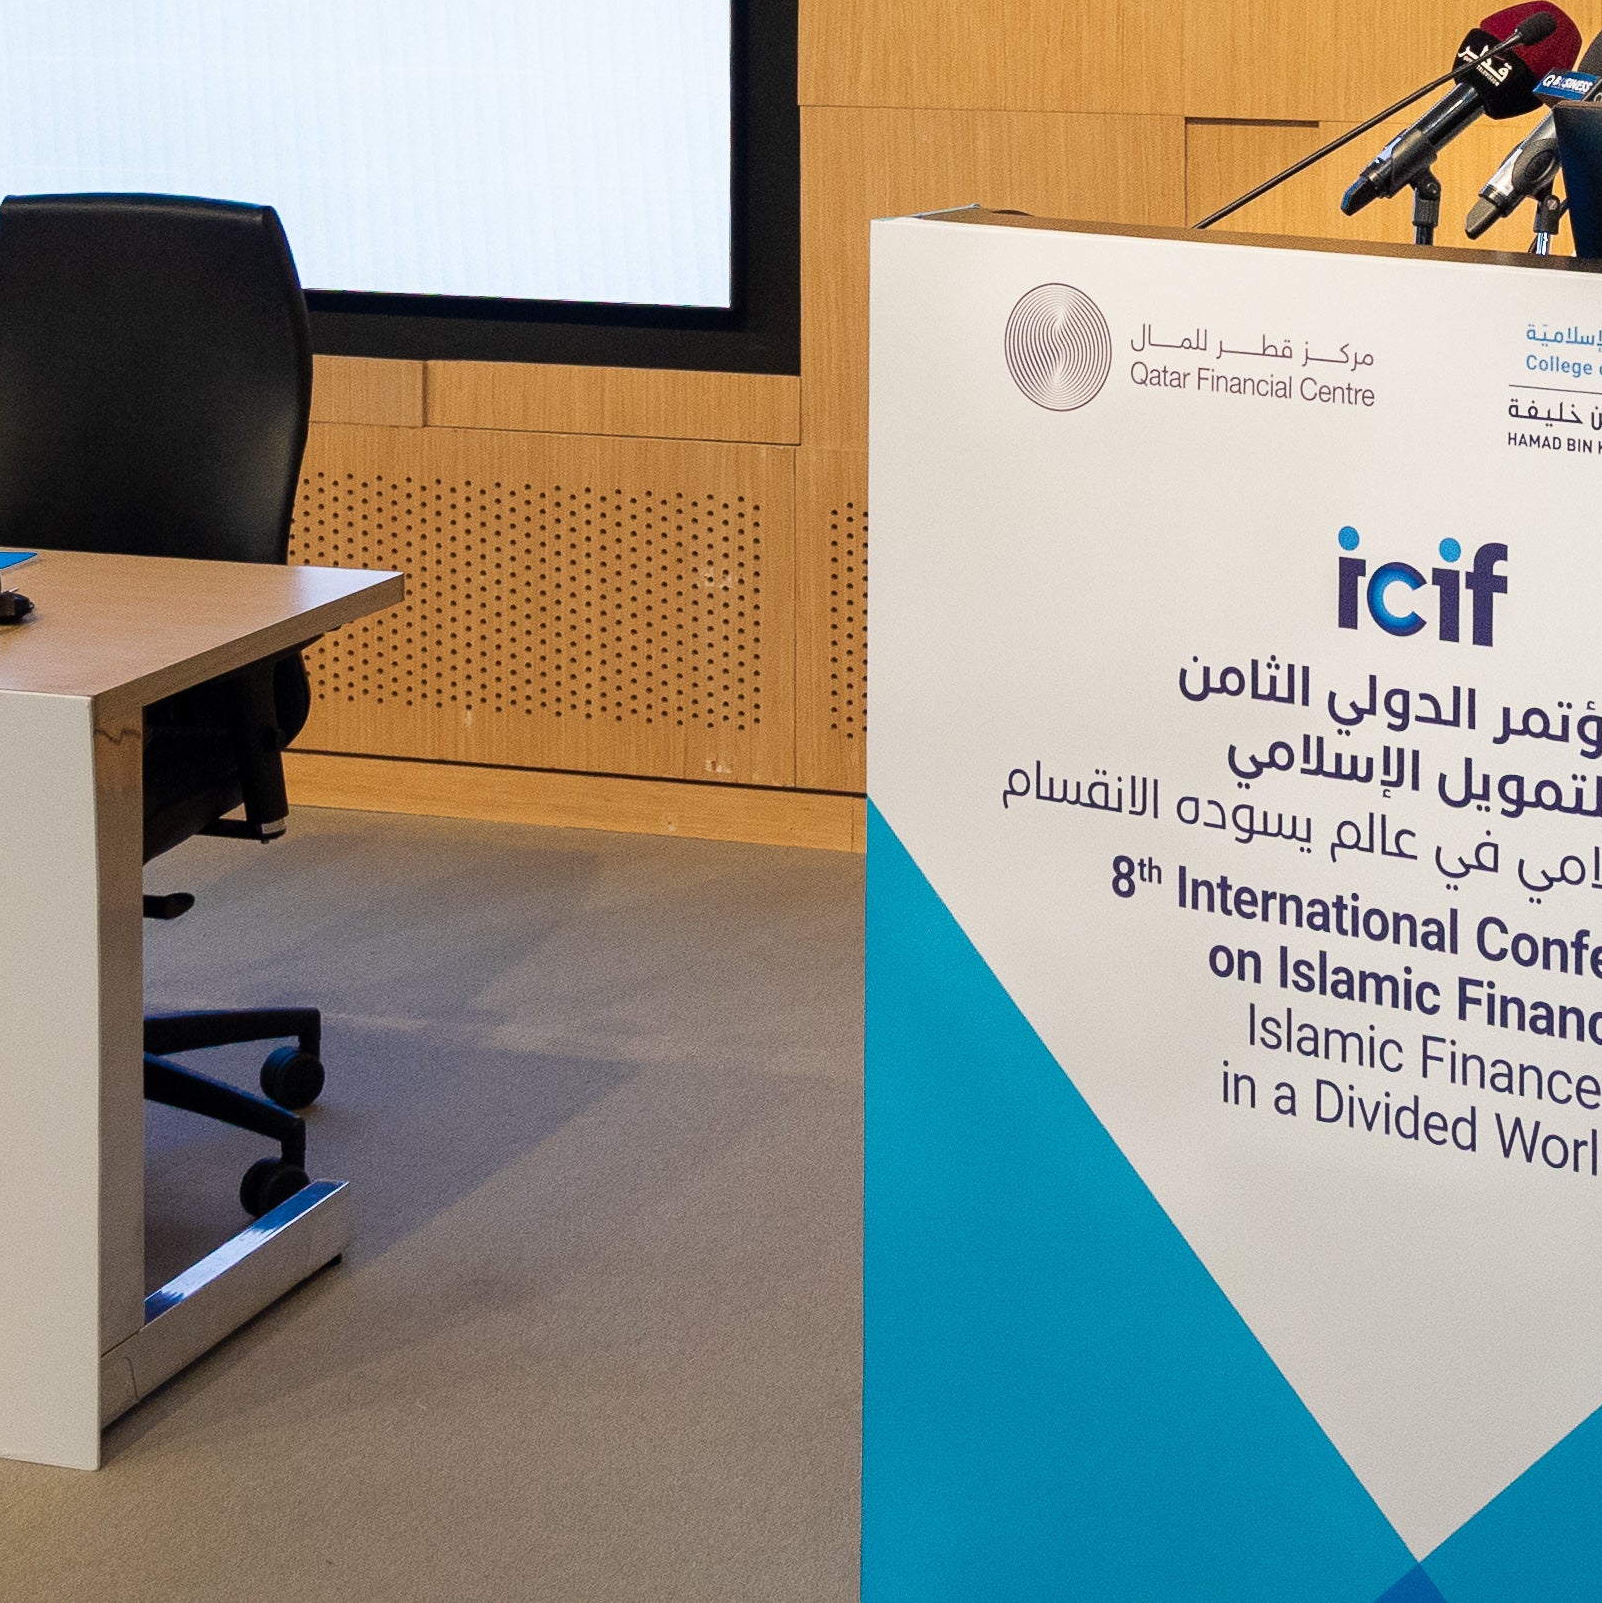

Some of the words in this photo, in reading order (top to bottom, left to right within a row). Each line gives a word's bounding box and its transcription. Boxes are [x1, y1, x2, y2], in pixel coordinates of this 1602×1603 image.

[1131, 324, 1207, 351] للمال
[1216, 334, 1292, 359] قطر
[1302, 344, 1373, 371] مركز
[1527, 355, 1592, 378] College
[1131, 362, 1190, 388] Qatar
[1198, 368, 1292, 398] Financial
[1300, 377, 1374, 406] Centre
[1508, 399, 1583, 427] خليفة
[1508, 432, 1561, 450] HAMAD
[1567, 438, 1592, 453] BIN
[1338, 526, 1508, 647] icif
[1179, 655, 1309, 707] الثامن
[1328, 675, 1475, 736] الدولي
[1003, 760, 1158, 819] الانقسام
[1228, 729, 1419, 798] الإسلامي
[1177, 782, 1311, 853] يسوده
[1331, 812, 1417, 863] عالم
[1435, 830, 1498, 891] في
[1179, 865, 1458, 955] International
[1209, 945, 1261, 984] on
[1280, 946, 1440, 1015] Islamic
[1250, 1003, 1403, 1072] Islamic
[1422, 1035, 1601, 1110] Finance
[1223, 1060, 1255, 1108] in
[1274, 1082, 1296, 1116] a
[1316, 1079, 1476, 1152] Divided
